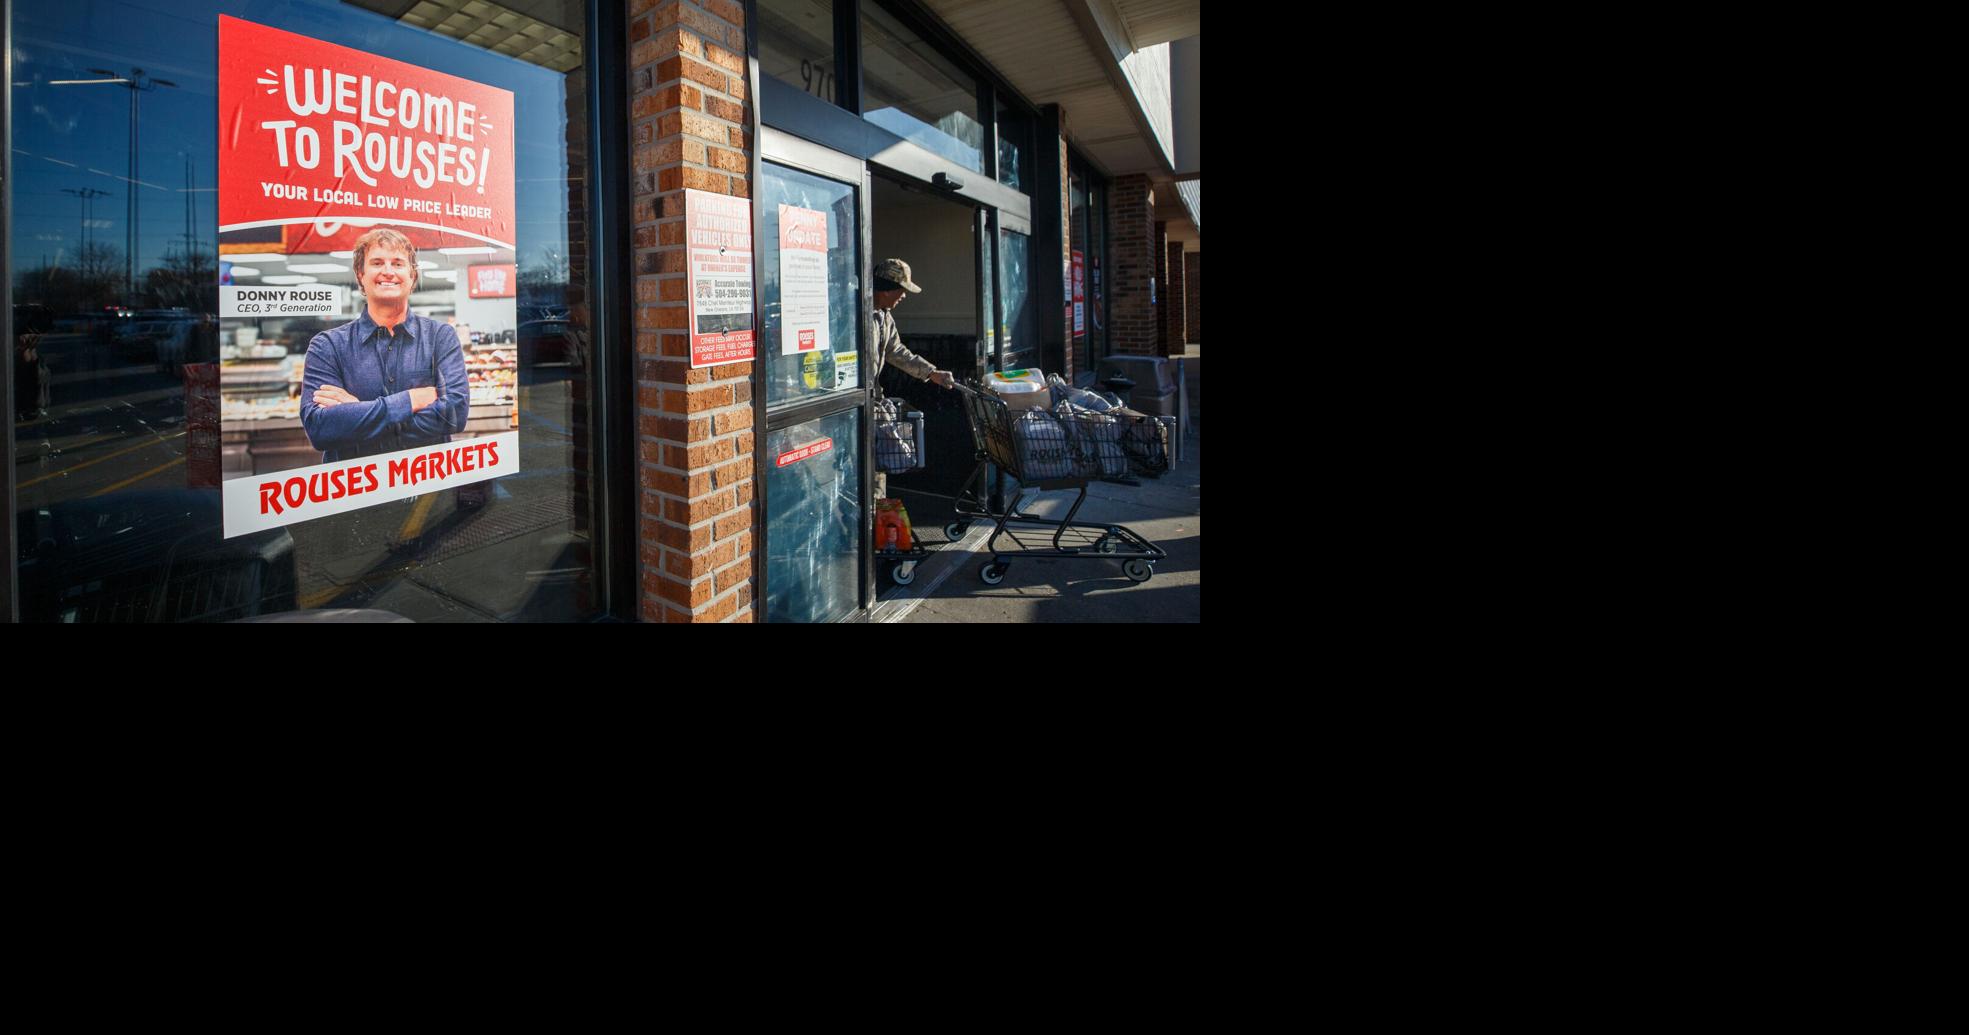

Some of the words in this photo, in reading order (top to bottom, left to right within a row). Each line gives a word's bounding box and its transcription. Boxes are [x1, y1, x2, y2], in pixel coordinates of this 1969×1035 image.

[284, 64, 476, 141] WELCOME
[261, 120, 321, 169] TO
[333, 120, 490, 194] ROUSES!
[261, 182, 308, 201] YOUR
[313, 188, 363, 206] LOCAL
[368, 194, 399, 210] LOW
[403, 199, 442, 215] PRICE
[446, 204, 492, 219] LEADER
[696, 213, 748, 233] AUTHORIZED
[691, 229, 732, 248] VEHICLES
[733, 234, 751, 248] ONLY
[714, 280, 735, 288] Accurate
[735, 280, 751, 288] Towing
[237, 291, 287, 301] DONNY
[290, 291, 332, 301] ROUSE
[237, 303, 262, 314] CEO,
[264, 303, 278, 313] 3rd
[280, 303, 332, 313] Generation
[695, 345, 715, 353] STORAGE
[259, 463, 378, 515] ROUSES
[388, 441, 499, 487] MARKETS
